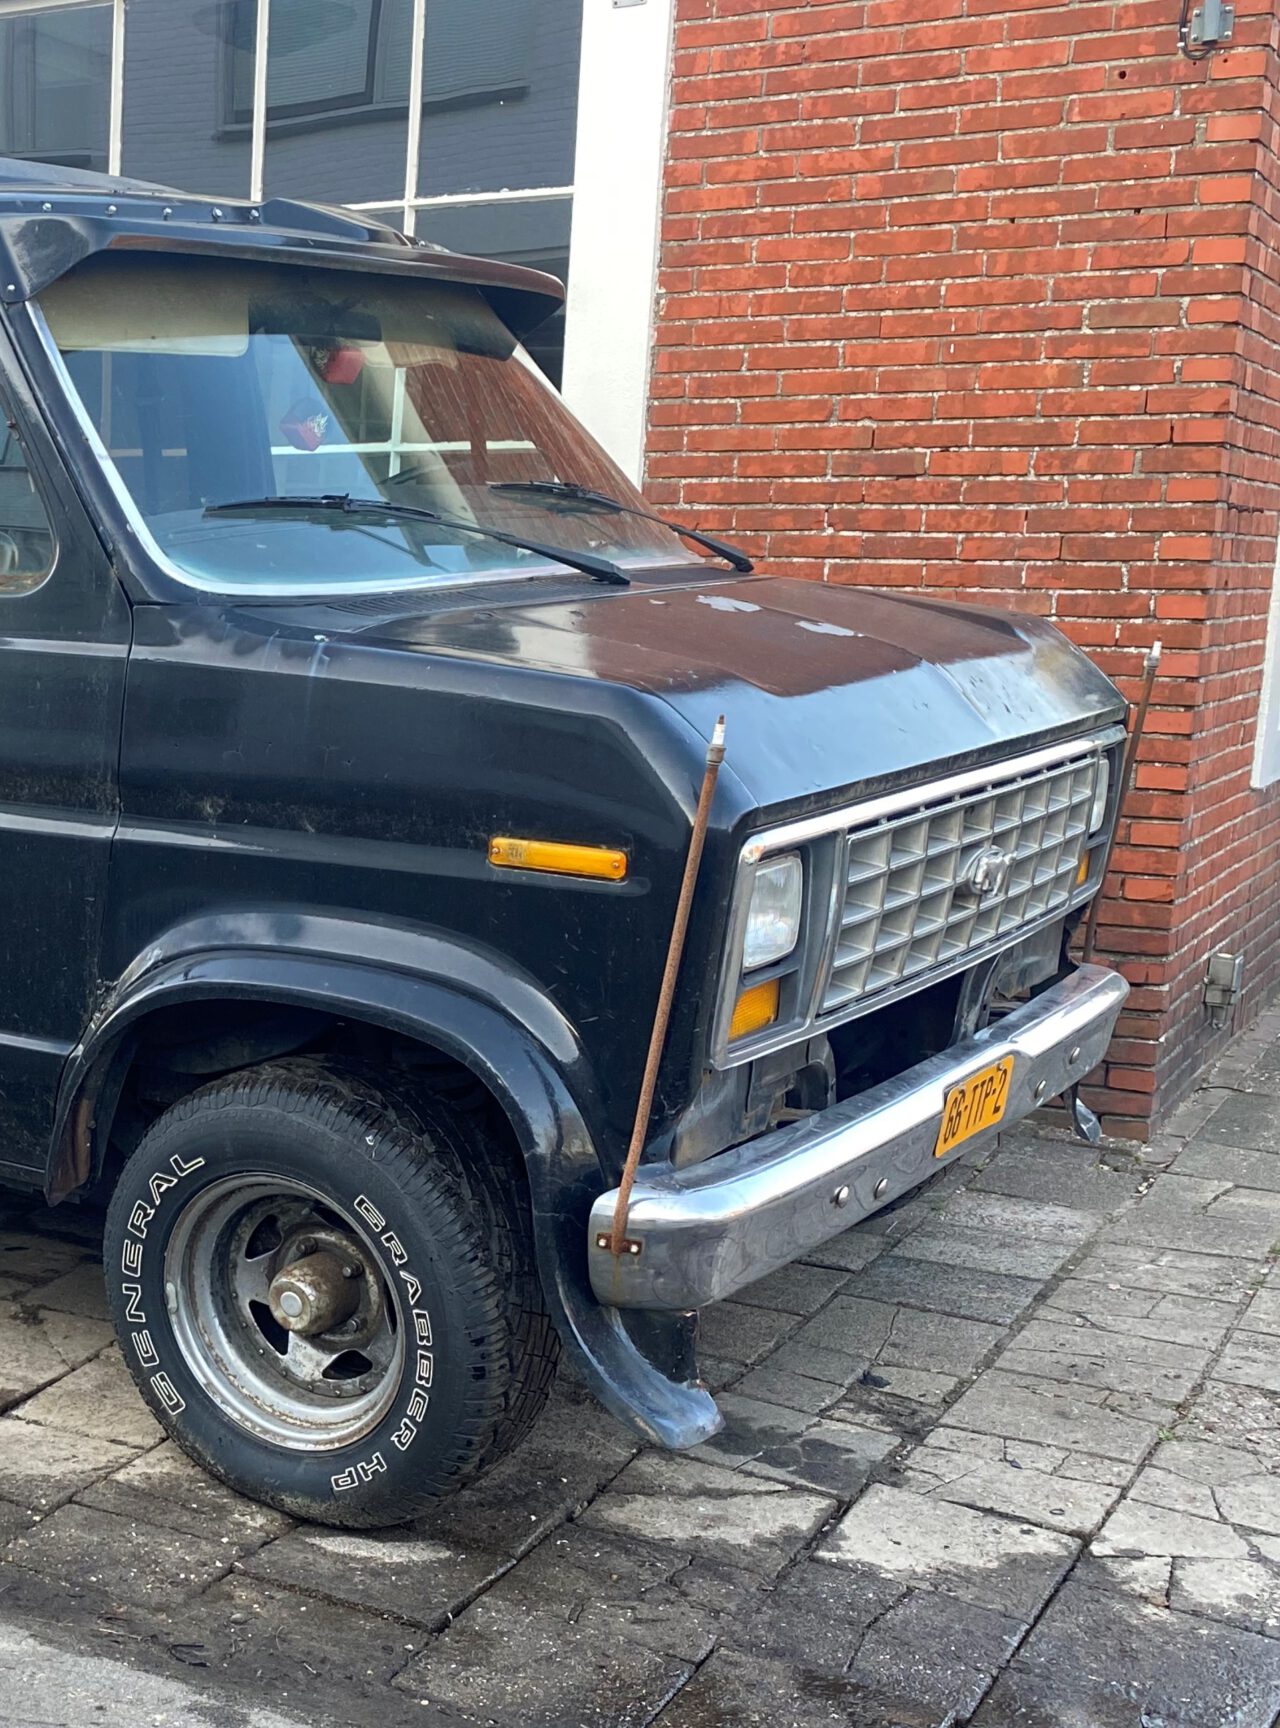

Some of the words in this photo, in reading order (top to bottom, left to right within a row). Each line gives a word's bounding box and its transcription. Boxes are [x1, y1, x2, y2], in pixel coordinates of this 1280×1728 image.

[943, 1068, 1008, 1144] 66-TTP-2
[122, 1153, 206, 1415] GENERAL
[353, 1194, 434, 1451] GRABBER
[330, 1451, 387, 1491] HP
